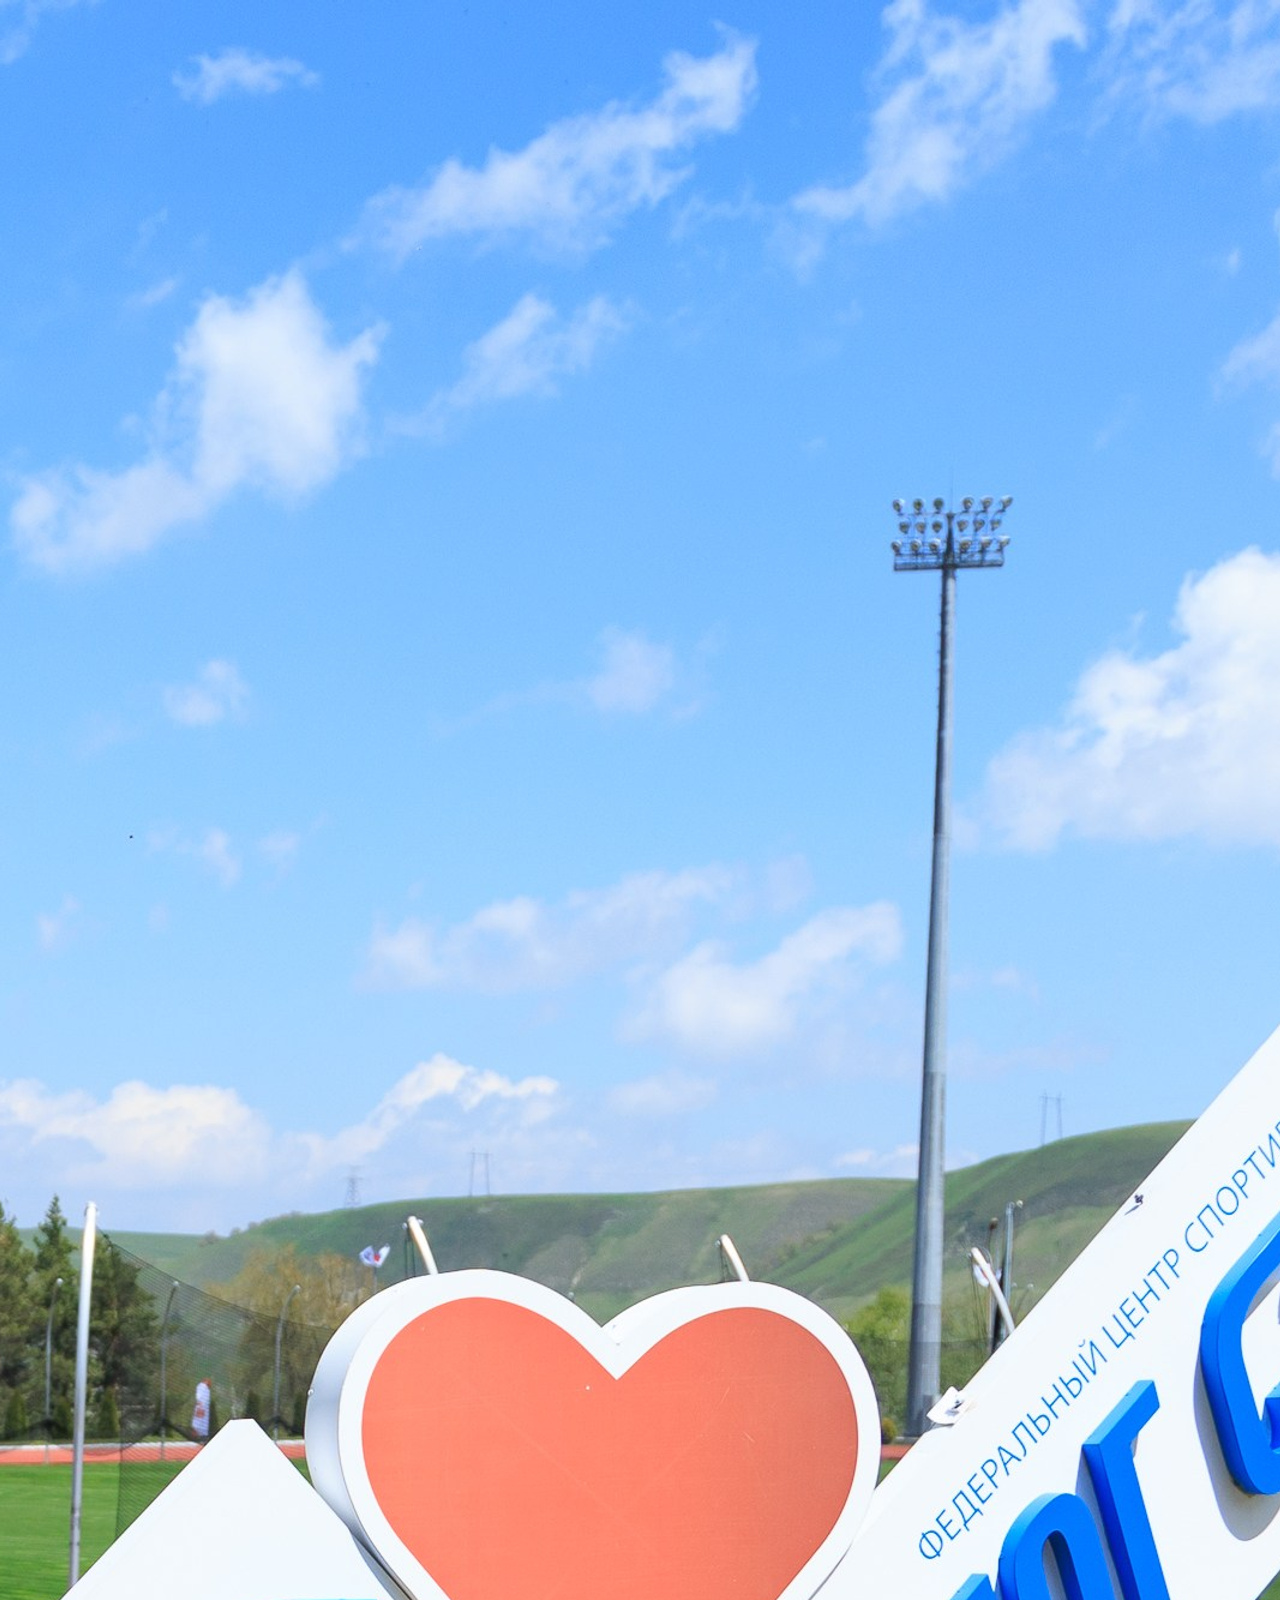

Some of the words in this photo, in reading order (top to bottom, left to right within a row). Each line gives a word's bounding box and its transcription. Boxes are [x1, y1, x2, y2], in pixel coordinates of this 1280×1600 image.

[918, 1339, 1108, 1560] ФЕДЕРАЛЬНЫЙ
[1101, 1247, 1180, 1350] ЦЕНТР
[1184, 1120, 1280, 1253] СПОРТИ
